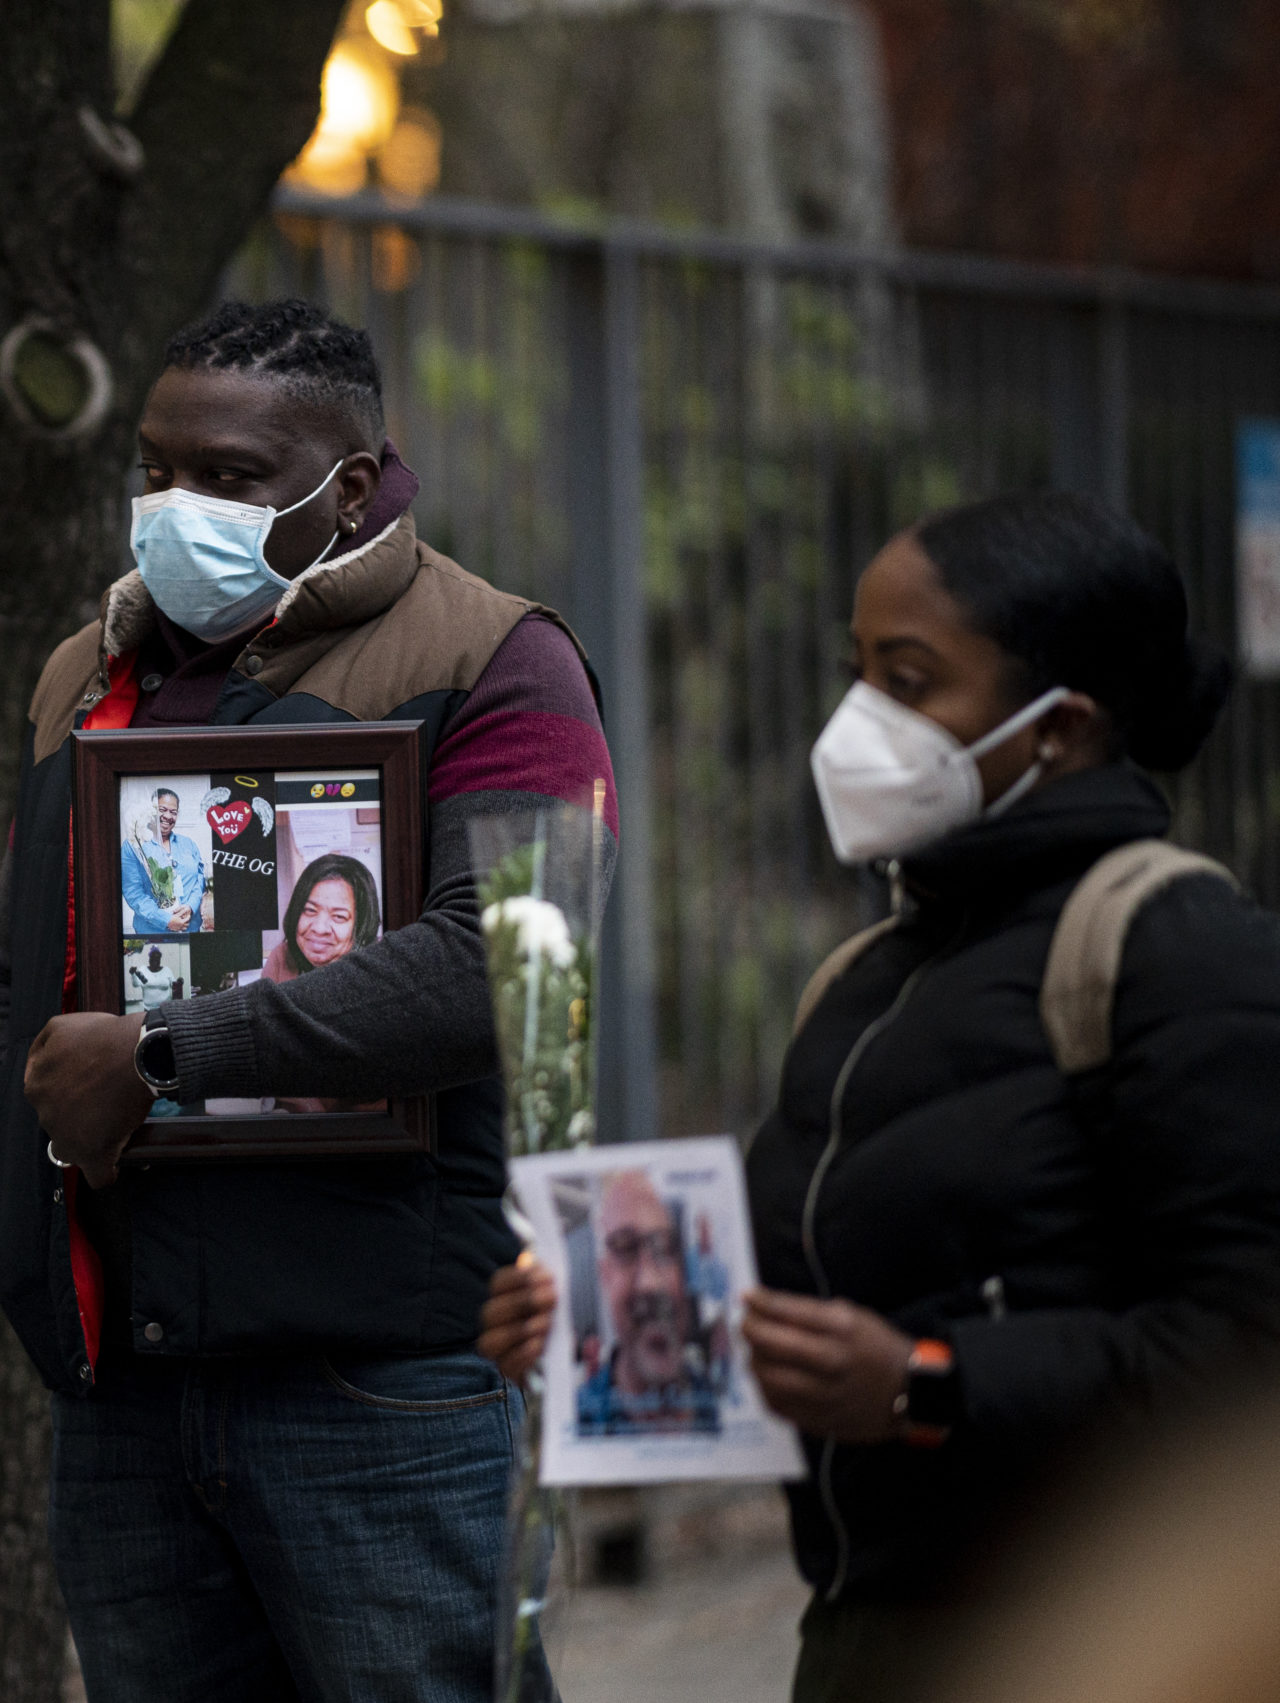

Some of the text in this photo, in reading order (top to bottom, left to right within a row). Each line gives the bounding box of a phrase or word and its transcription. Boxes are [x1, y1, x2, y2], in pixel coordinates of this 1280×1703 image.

[210, 809, 243, 824] LOVE
[212, 849, 274, 875] THE OG
